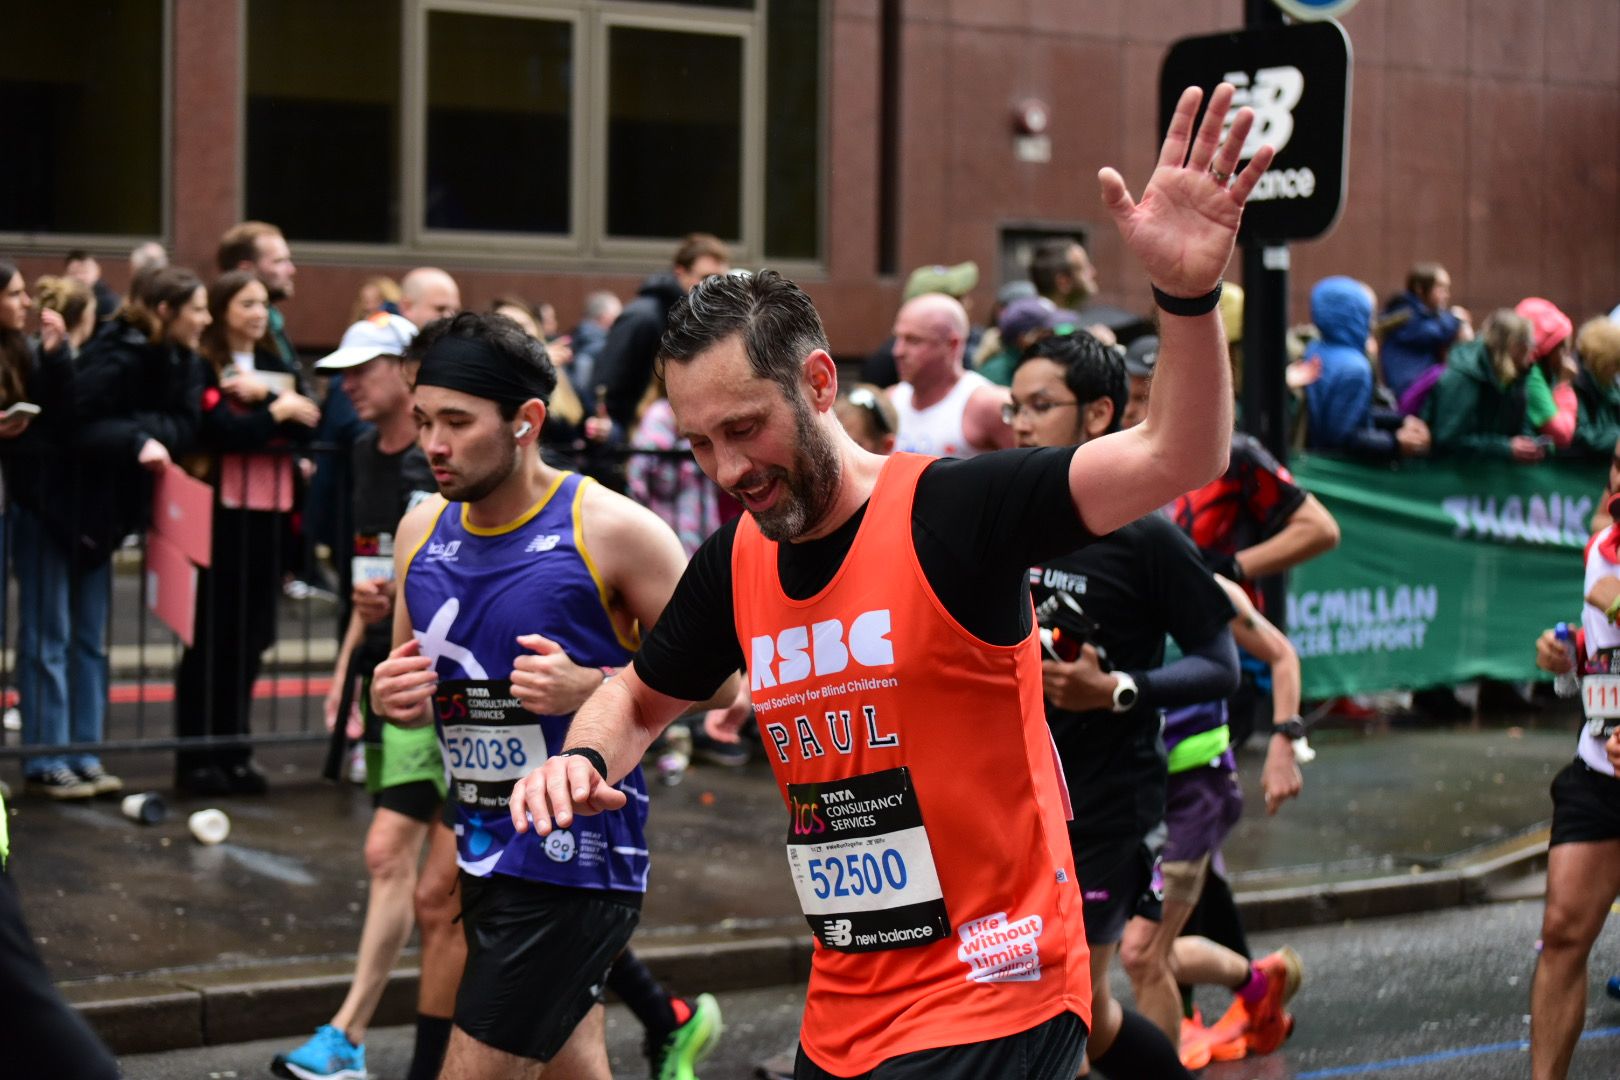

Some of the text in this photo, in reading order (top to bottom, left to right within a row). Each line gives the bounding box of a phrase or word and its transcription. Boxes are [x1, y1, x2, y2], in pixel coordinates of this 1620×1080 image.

[1443, 492, 1591, 546] THANK
[1043, 568, 1087, 595] Ultra
[1286, 584, 1438, 629] CMILLAN
[751, 608, 895, 692] RSBC
[1338, 622, 1426, 654] SUPPORT
[466, 688, 490, 698] TATA
[467, 698, 522, 709] CONSULTANC
[752, 677, 898, 715] Royal Society for Blind Children
[469, 709, 506, 720] SERVICES
[766, 705, 900, 764] PAUL
[447, 737, 528, 770] 52038
[820, 789, 856, 804] TATA
[826, 793, 903, 818] CONSULTANCY
[831, 814, 877, 831] SERVICES
[808, 848, 908, 899] 52500
[855, 925, 933, 946] new balance
[968, 918, 999, 937] Life
[974, 943, 1033, 970] Limits
